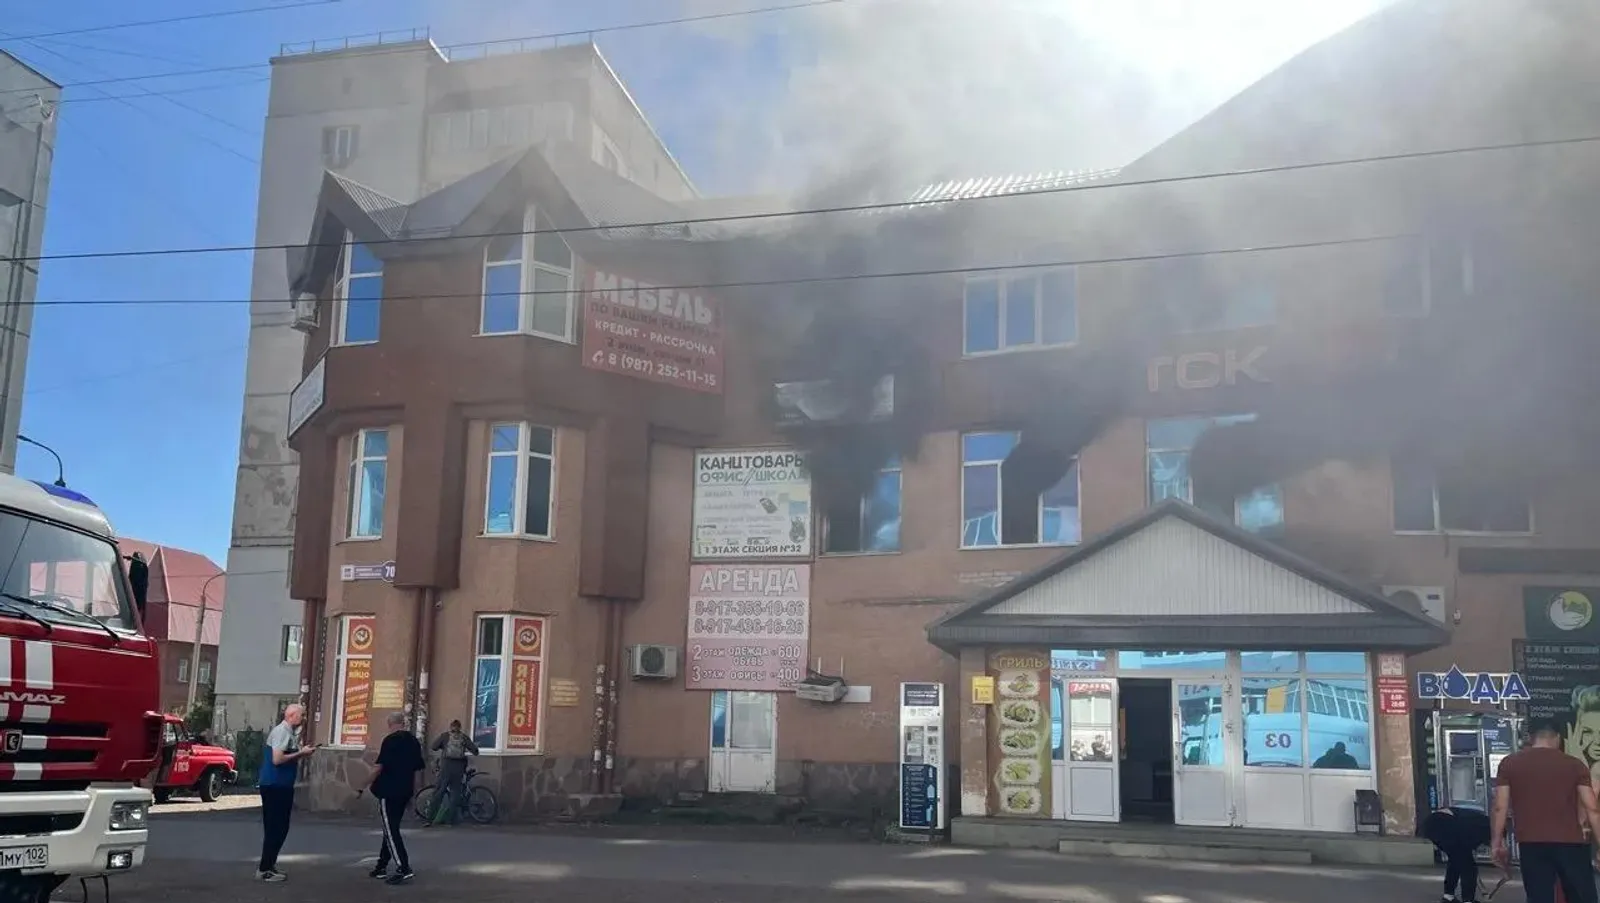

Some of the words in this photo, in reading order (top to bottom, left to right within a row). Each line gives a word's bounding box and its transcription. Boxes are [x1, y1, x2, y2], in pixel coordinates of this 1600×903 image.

[591, 271, 712, 325] МЕБЕЛЬ
[591, 302, 608, 314] ПО
[595, 319, 640, 338] КРЕДИТ
[650, 333, 716, 356] РАССРОЧКА
[608, 353, 617, 365] 8
[621, 355, 653, 375] (987)
[657, 363, 717, 386] 252-11-15
[700, 470, 743, 483] ОФИС
[711, 545, 740, 554] ЭТАЖ
[741, 545, 778, 555] СЕКЦИЯ
[699, 568, 800, 596] АРЕНДА
[692, 644, 702, 660] 2
[729, 646, 768, 658] ОДЕЖДА
[778, 645, 800, 658] 600
[733, 656, 764, 666] ОБУВЬ
[999, 656, 1044, 669] ГРИЛЬ
[692, 666, 701, 682] 3
[730, 670, 765, 681] ОФИСЫ
[776, 668, 800, 681] 400
[1418, 664, 1530, 704] ВОДА
[0, 691, 66, 704] MAZ
[513, 664, 528, 728] ЯЙЦО
[25, 848, 44, 860] 102
